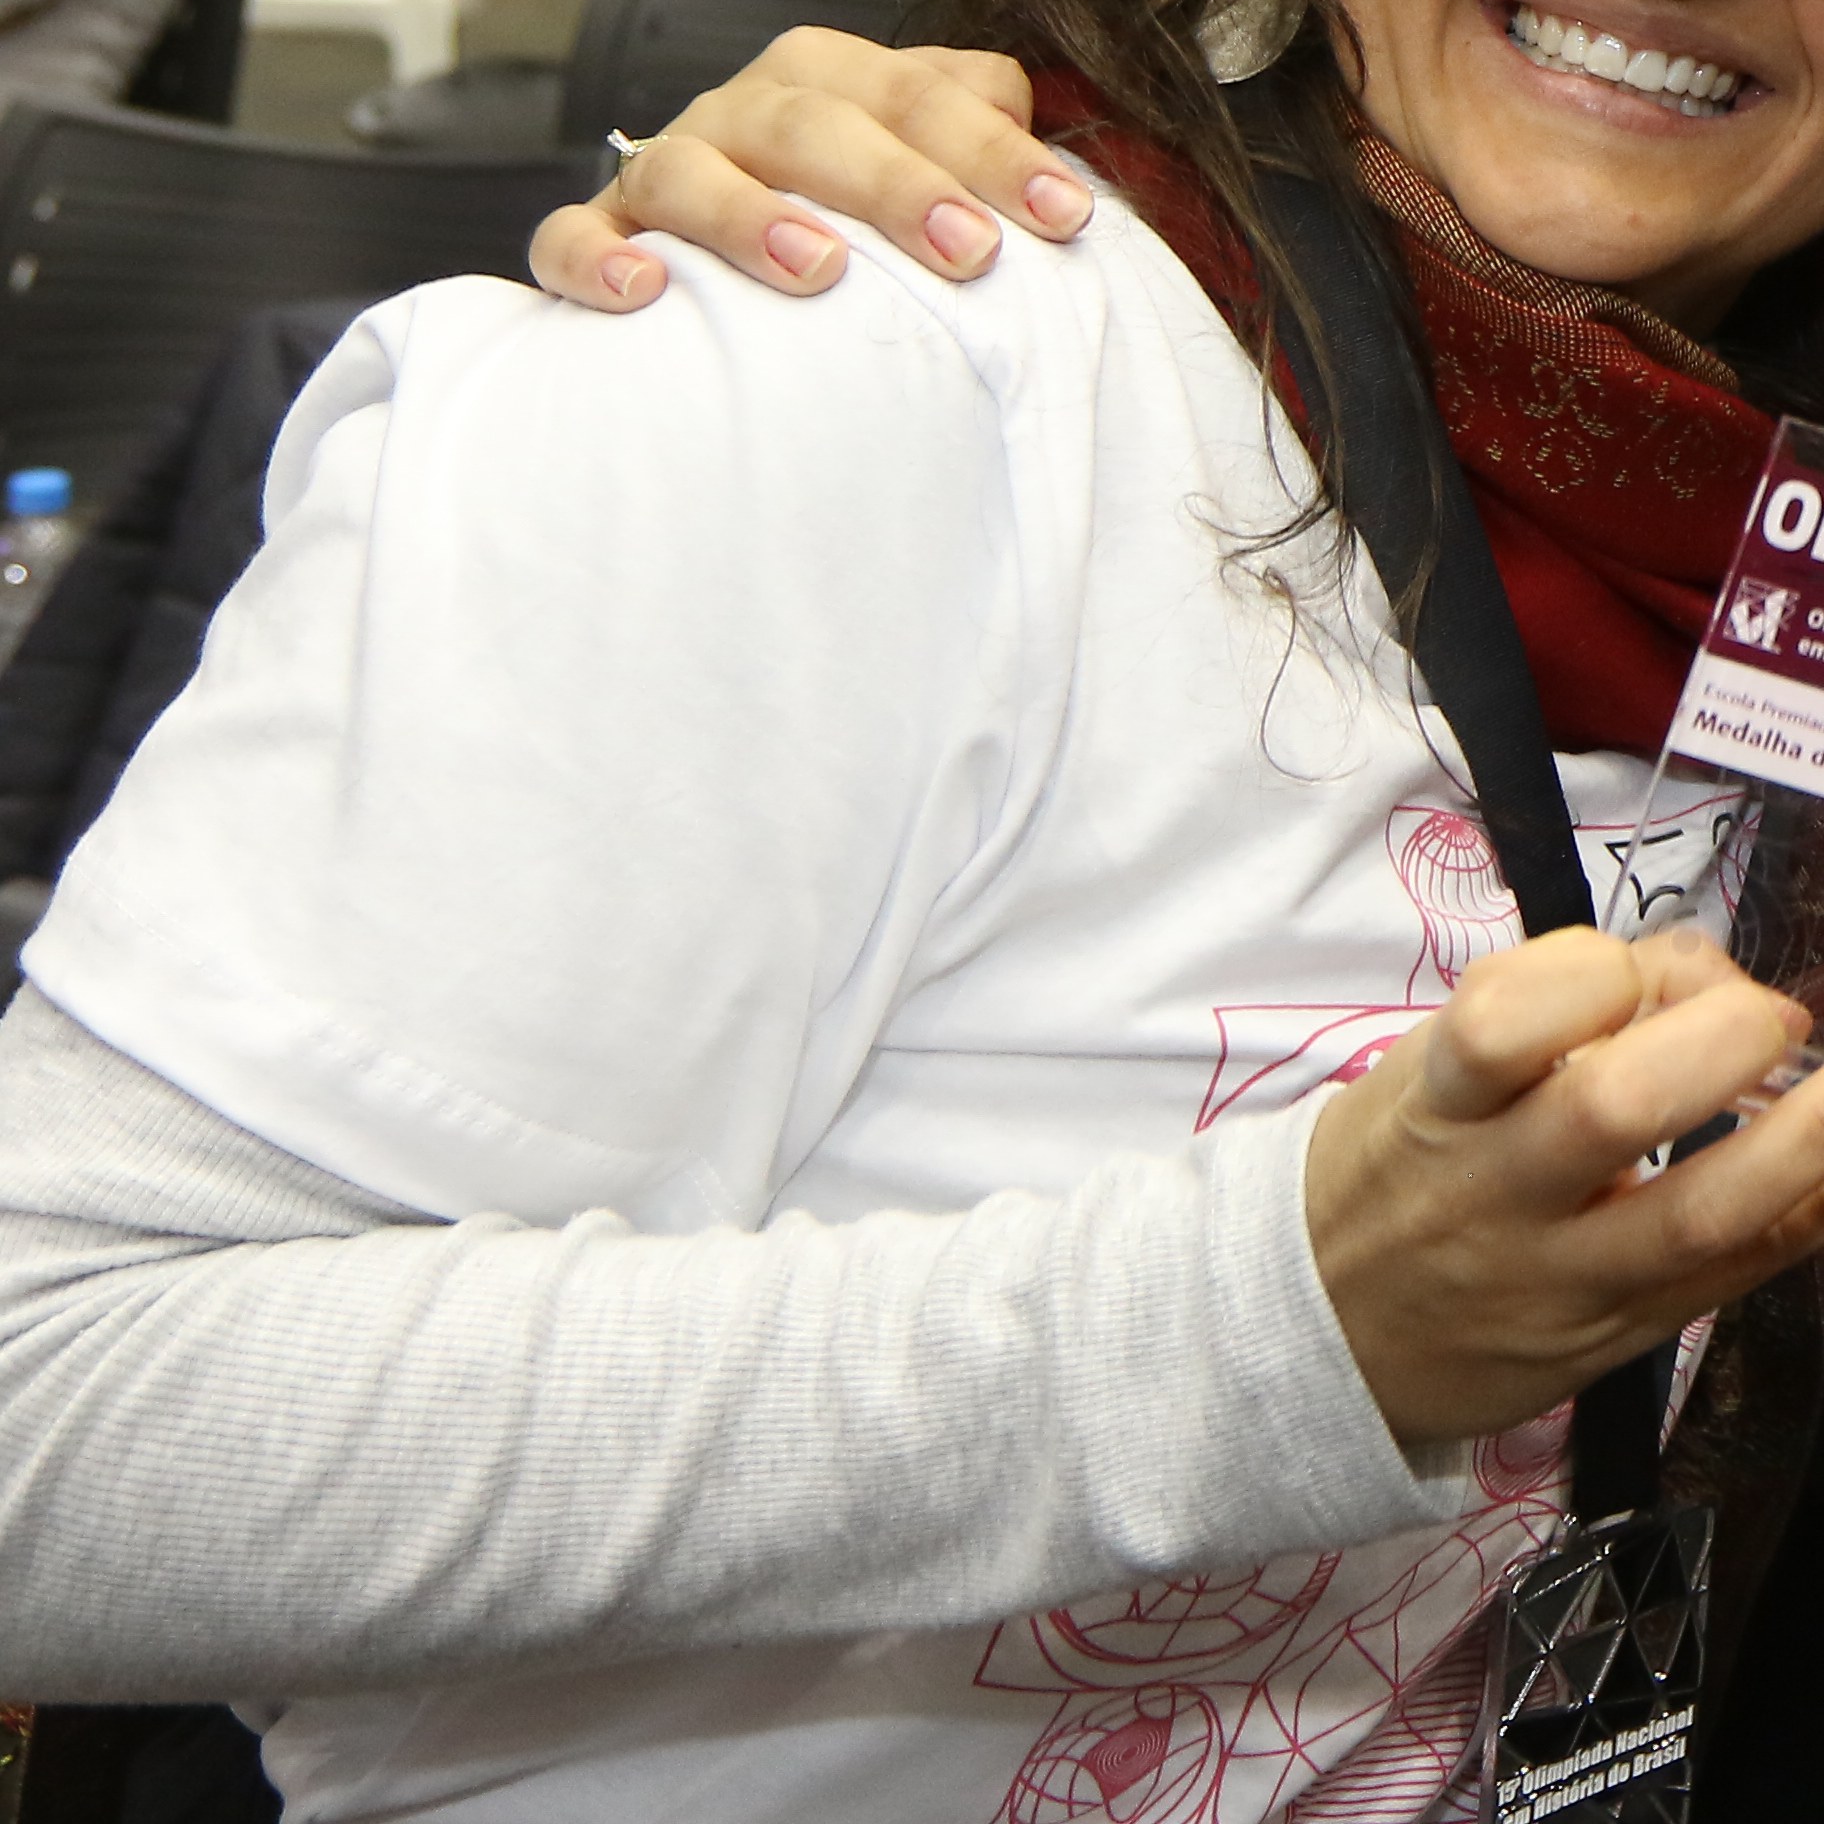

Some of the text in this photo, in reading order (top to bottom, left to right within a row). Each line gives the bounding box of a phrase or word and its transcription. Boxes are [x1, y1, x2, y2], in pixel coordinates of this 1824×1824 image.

[1693, 708, 1803, 763] Medalha
[1502, 1733, 1688, 1824] em História do Brasil
[1522, 1738, 1614, 1795] Olimpíada
[1614, 1703, 1695, 1756] Nacional
